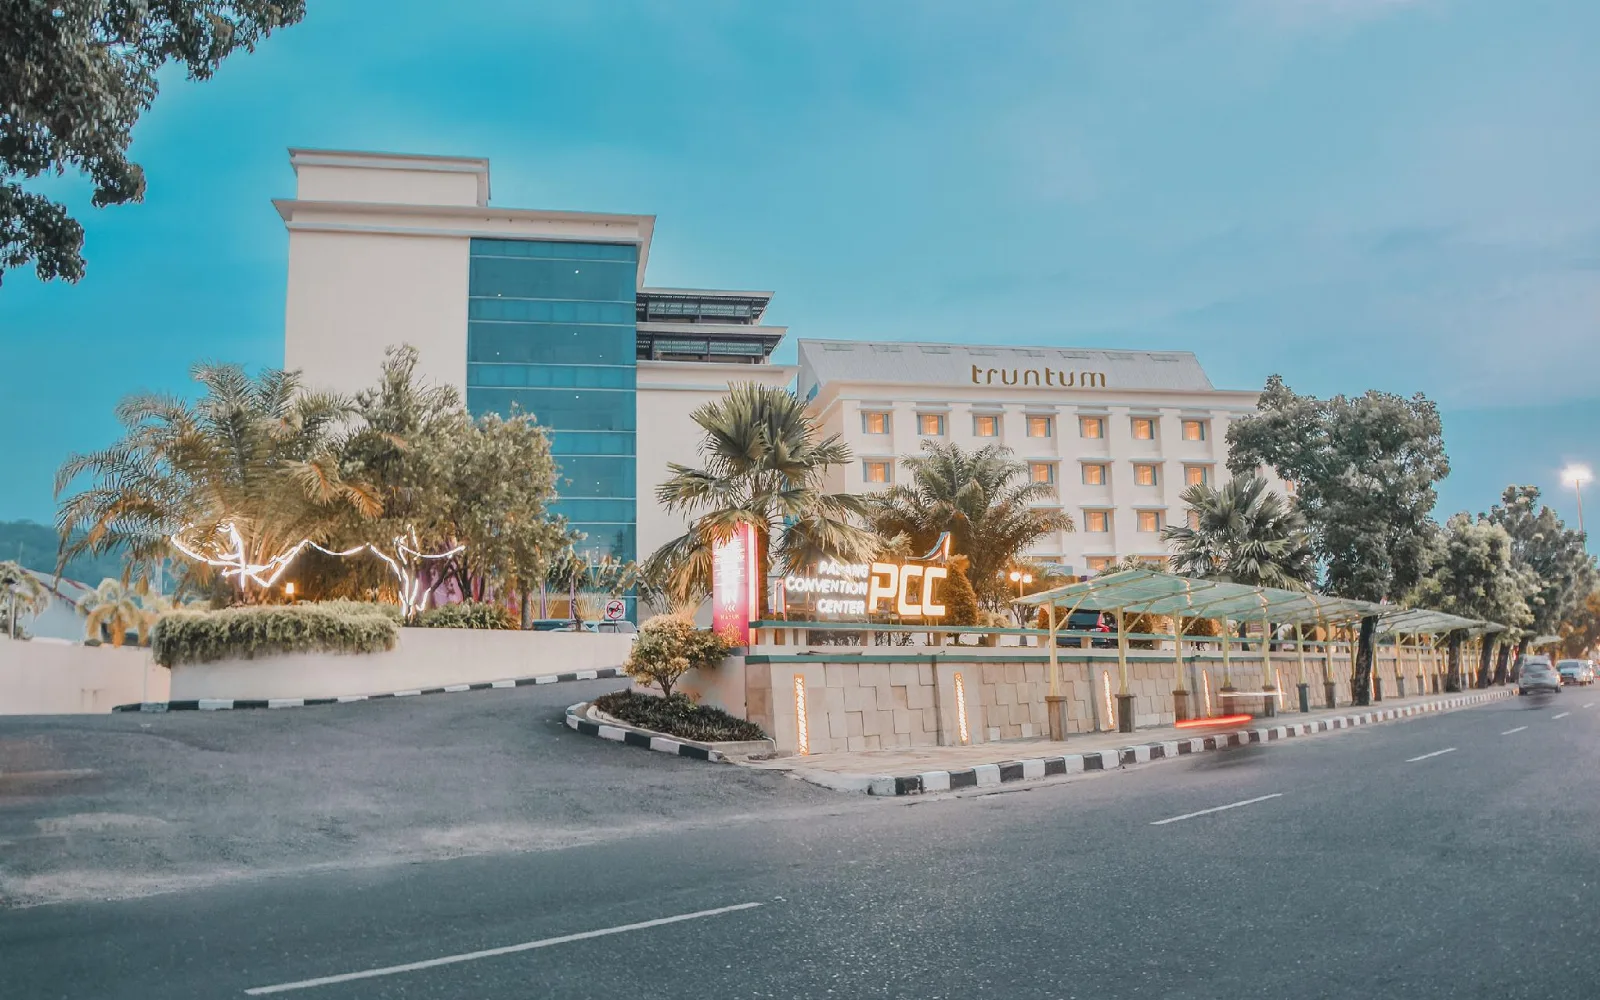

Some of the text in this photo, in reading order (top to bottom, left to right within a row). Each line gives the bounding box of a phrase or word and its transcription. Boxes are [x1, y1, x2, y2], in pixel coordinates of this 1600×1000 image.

[972, 364, 1105, 387] truntum
[785, 576, 868, 595] CONVENTION
[869, 563, 947, 616] PCC
[817, 599, 865, 614] CENTER
